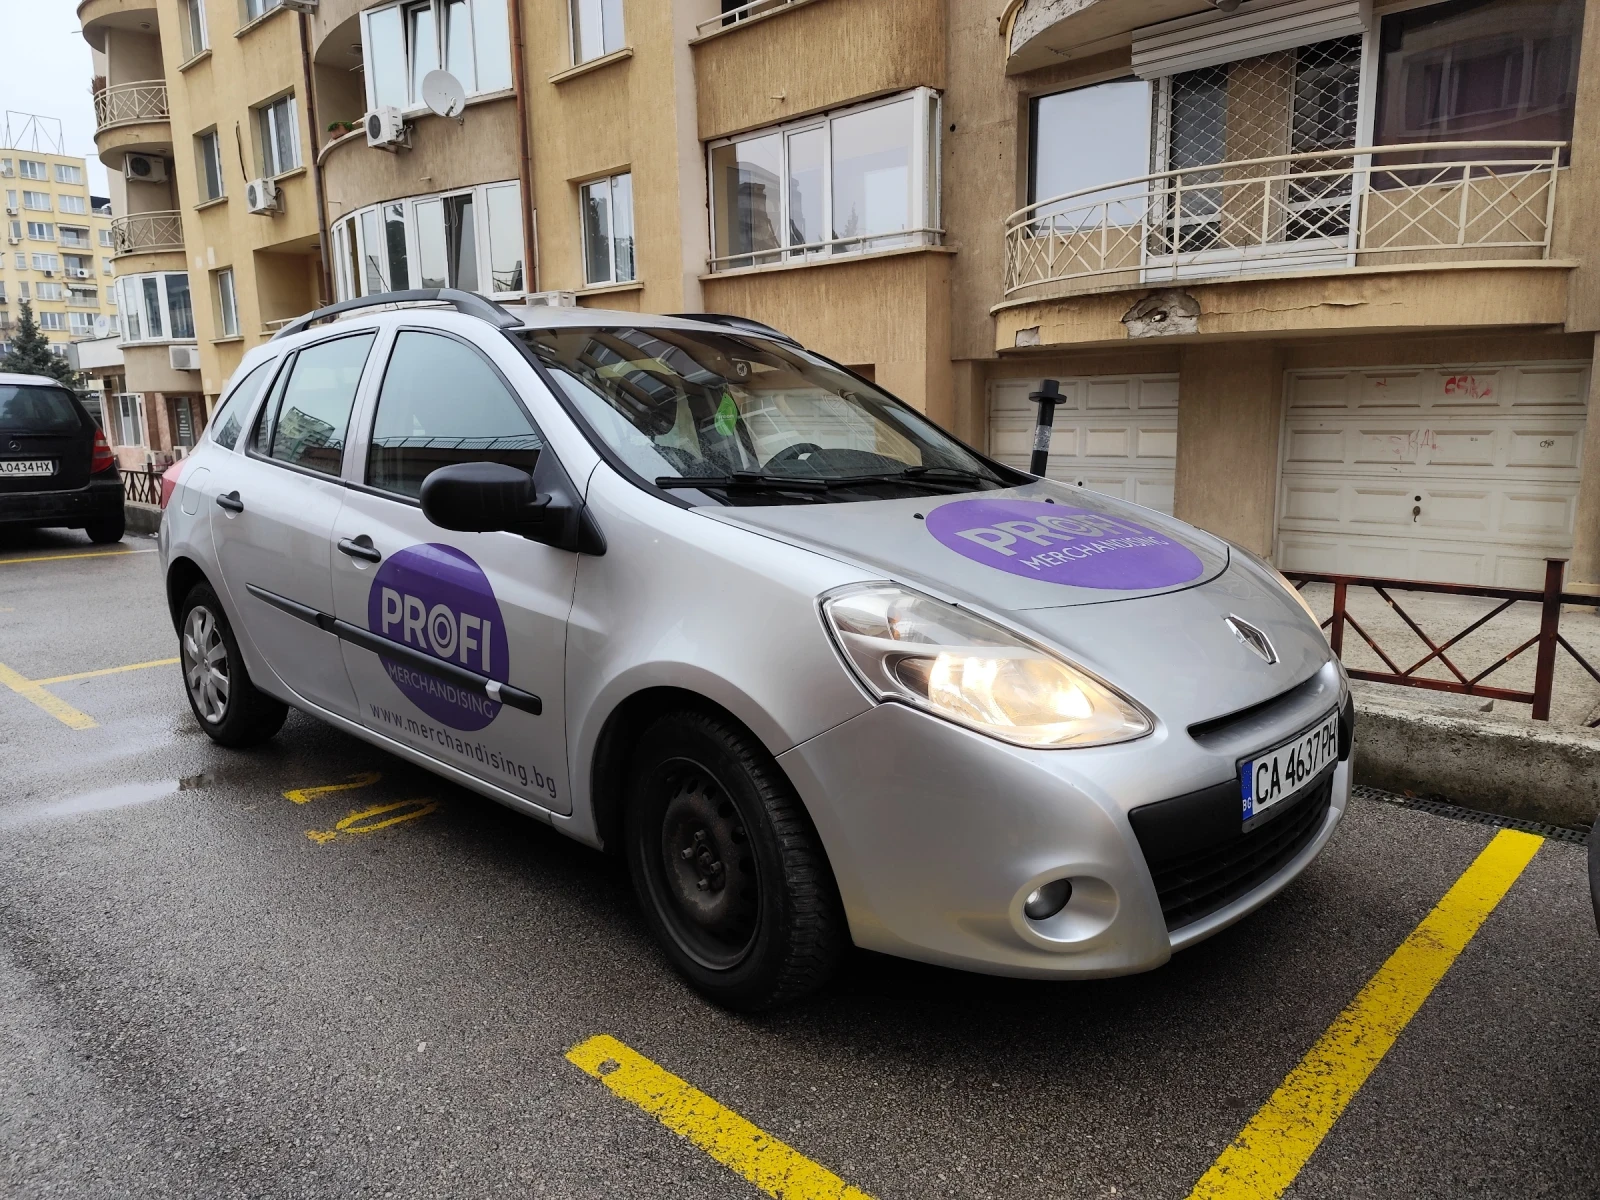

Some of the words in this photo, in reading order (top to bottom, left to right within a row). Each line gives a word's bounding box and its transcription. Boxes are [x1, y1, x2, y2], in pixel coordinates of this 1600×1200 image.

[953, 514, 1145, 557] PROFI
[381, 586, 492, 673] PROFI
[387, 662, 494, 719] MERCHANDISING
[369, 703, 557, 799] www.merchandising.bg
[1256, 756, 1281, 805] CA
[1285, 730, 1321, 787] 4637
[1321, 717, 1337, 764] PH
[1242, 797, 1252, 812] BG
